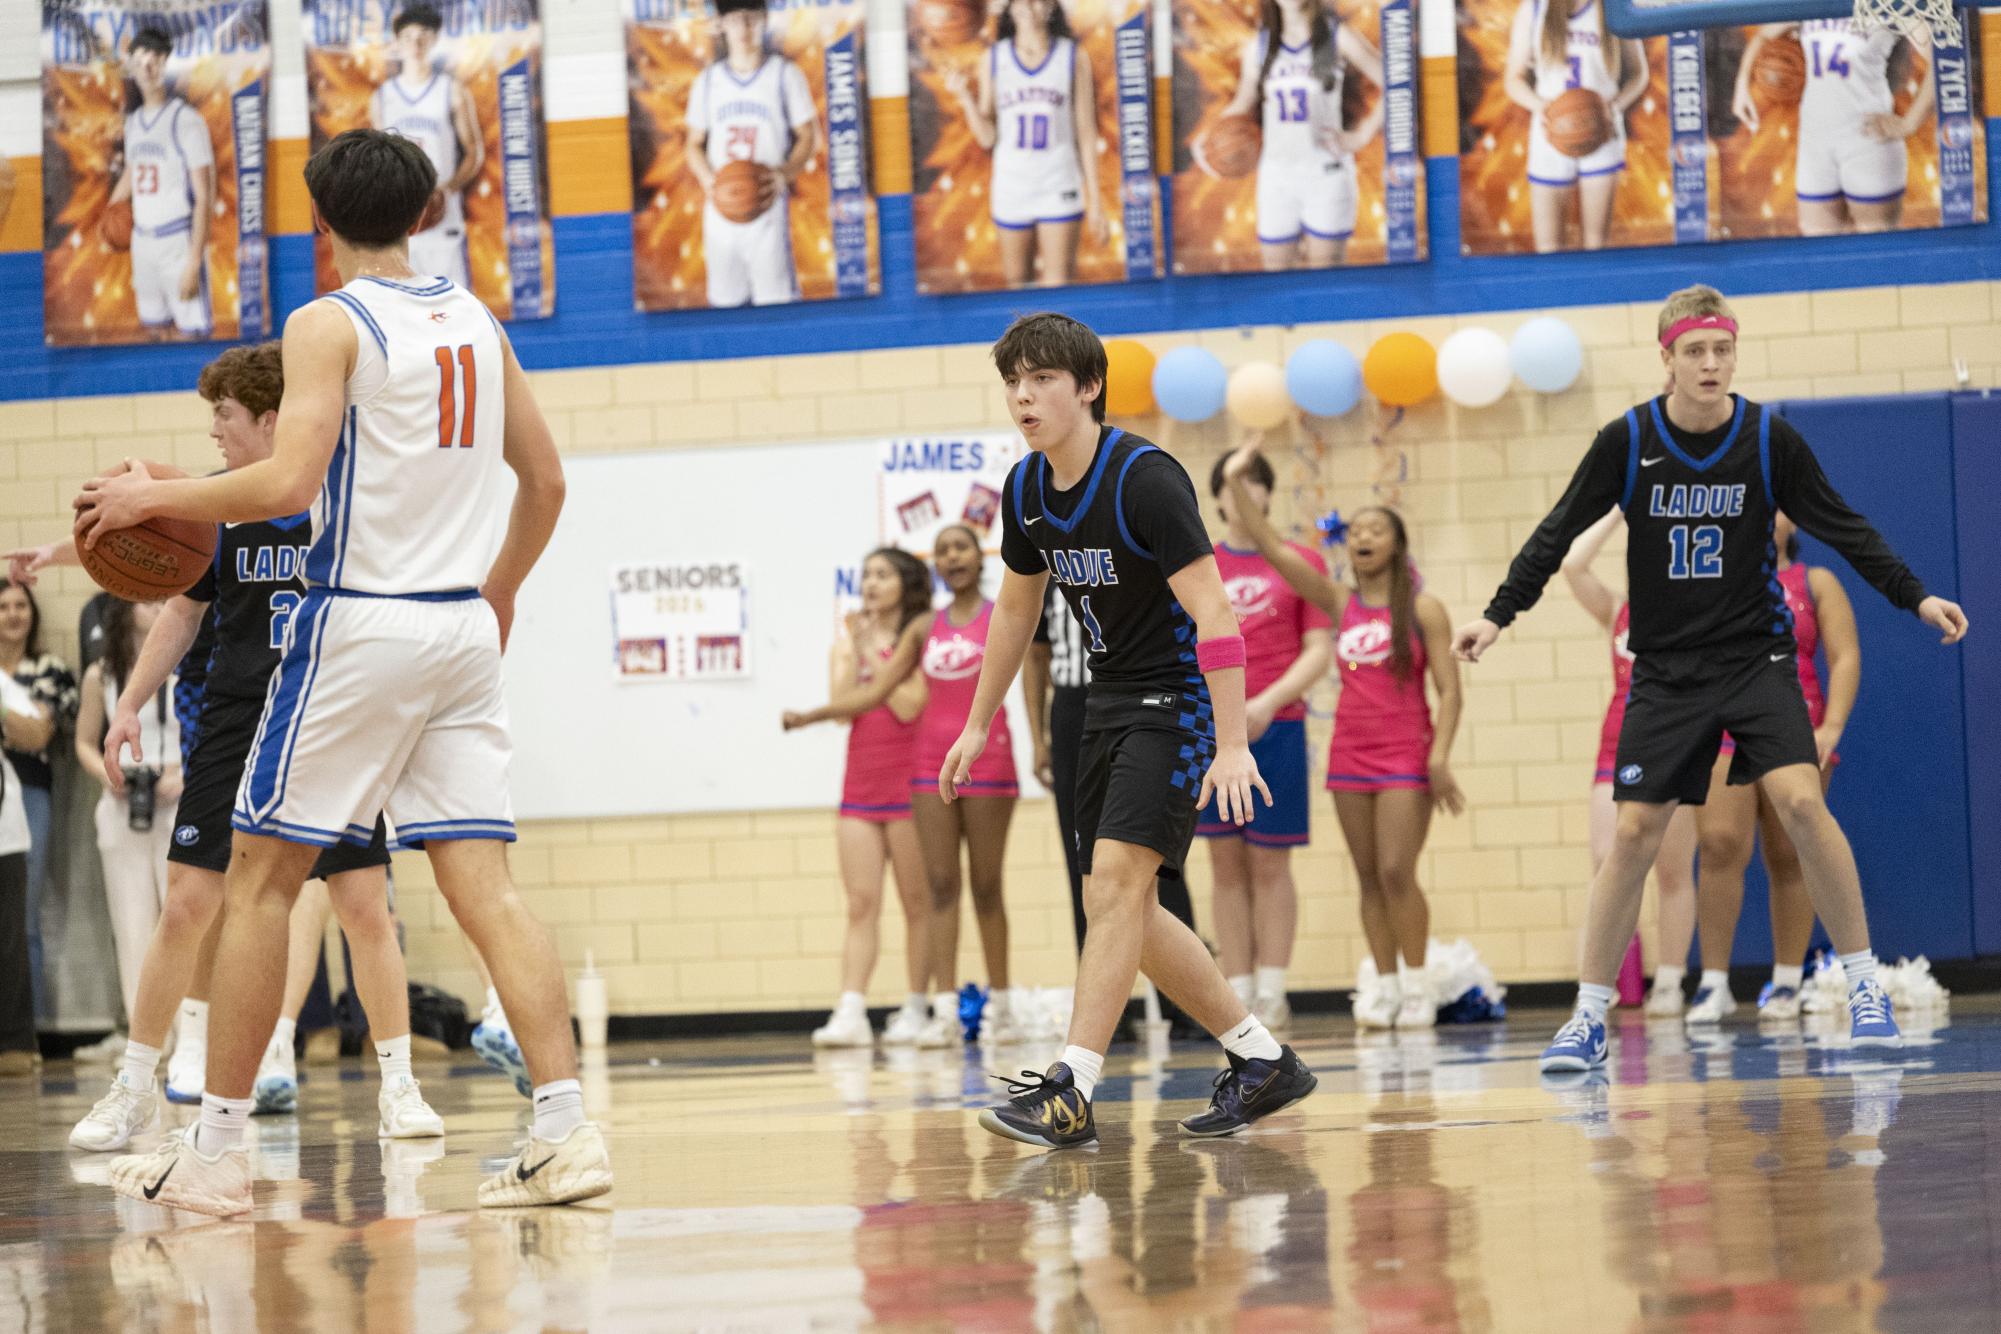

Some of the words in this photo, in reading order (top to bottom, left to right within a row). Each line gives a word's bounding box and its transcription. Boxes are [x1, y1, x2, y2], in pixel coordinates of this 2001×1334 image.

[1810, 41, 1850, 78] 14
[828, 51, 857, 122] JAMES
[1937, 57, 1968, 113] ZYCH
[1275, 88, 1309, 122] 13
[1017, 113, 1049, 150] 10
[831, 129, 861, 190] SONG
[136, 163, 158, 195] 23
[434, 344, 477, 449] 11
[883, 441, 984, 472] JAMES
[1649, 484, 1746, 518] LADUE
[103, 540, 180, 578] LEGACY
[1039, 547, 1119, 587] LADUE
[1668, 524, 1724, 579] 12
[617, 563, 741, 594] SENIORS
[1080, 595, 1107, 653] 1
